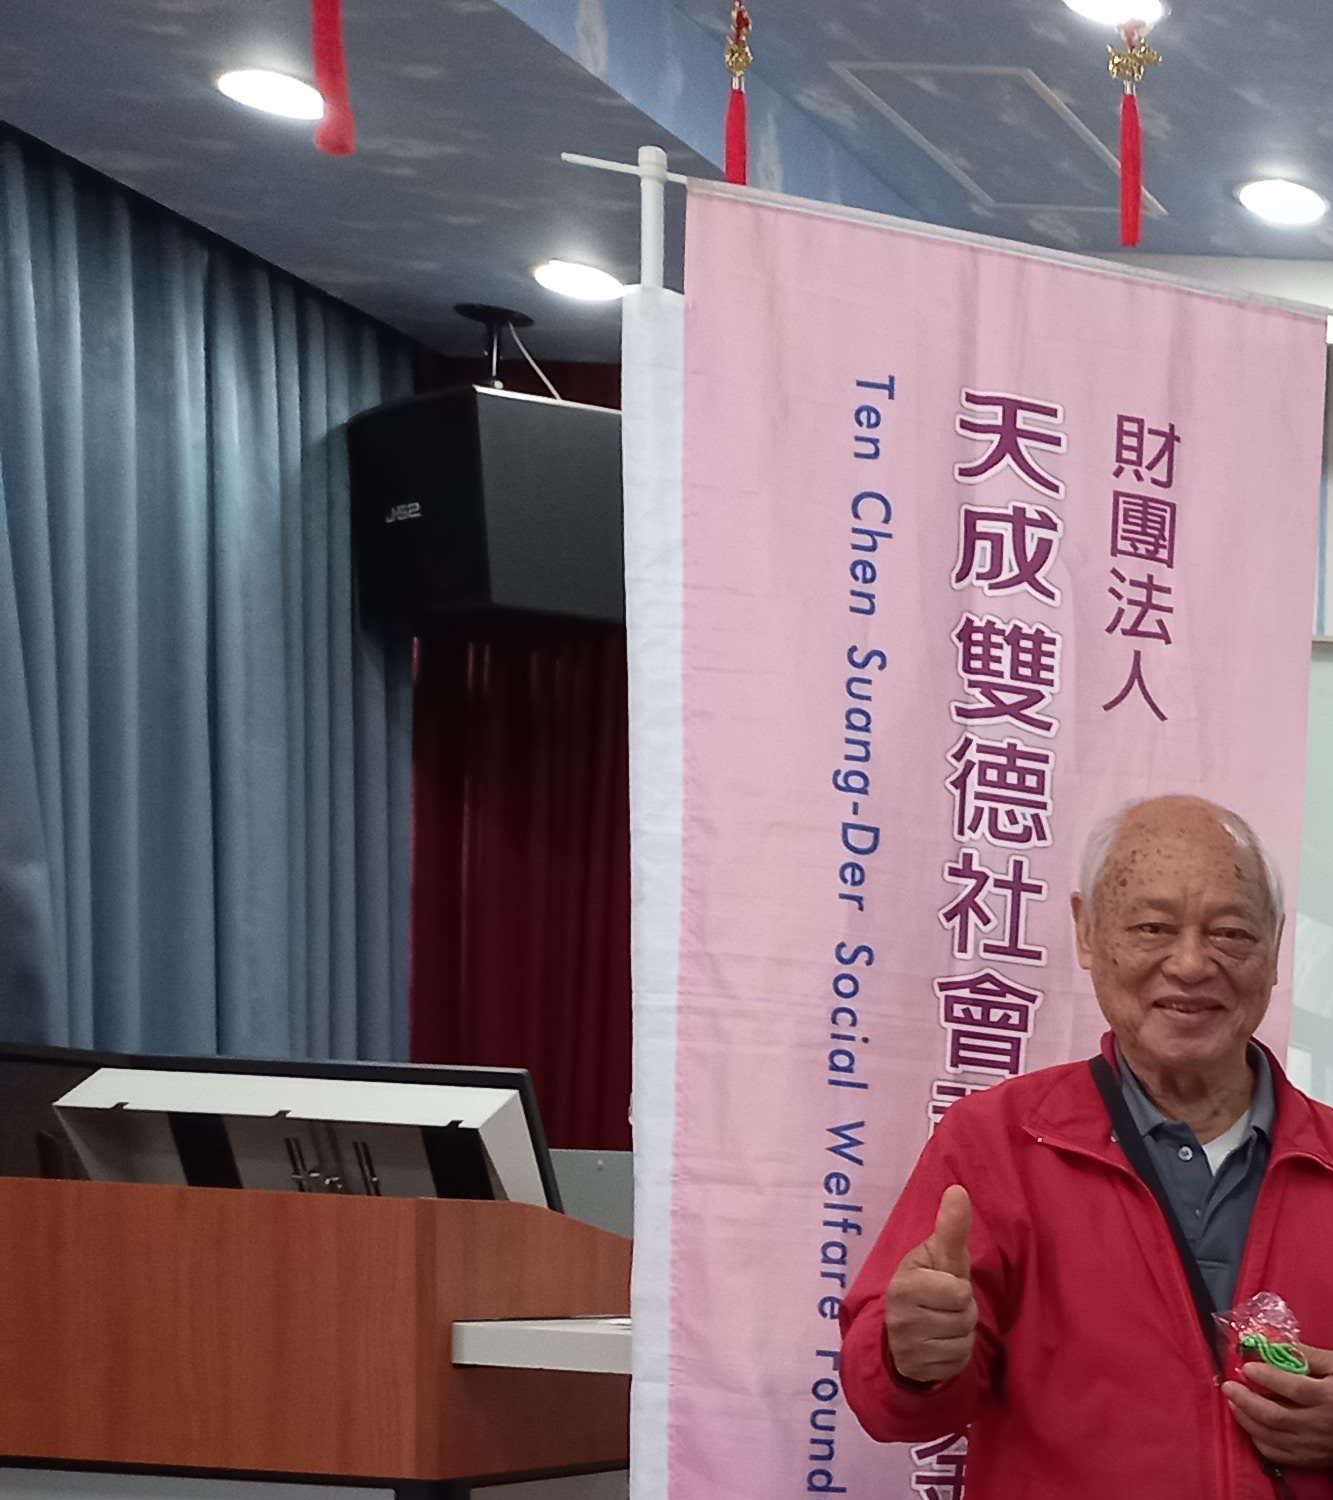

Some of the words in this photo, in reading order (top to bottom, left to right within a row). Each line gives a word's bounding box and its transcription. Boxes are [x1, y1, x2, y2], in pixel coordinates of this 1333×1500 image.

[853, 375, 895, 460] Ten
[849, 490, 893, 616] Chen
[1102, 413, 1181, 722] 財團法人
[832, 645, 888, 911] Suang-Der
[826, 941, 874, 1089] Social
[816, 1120, 865, 1320] Welfare
